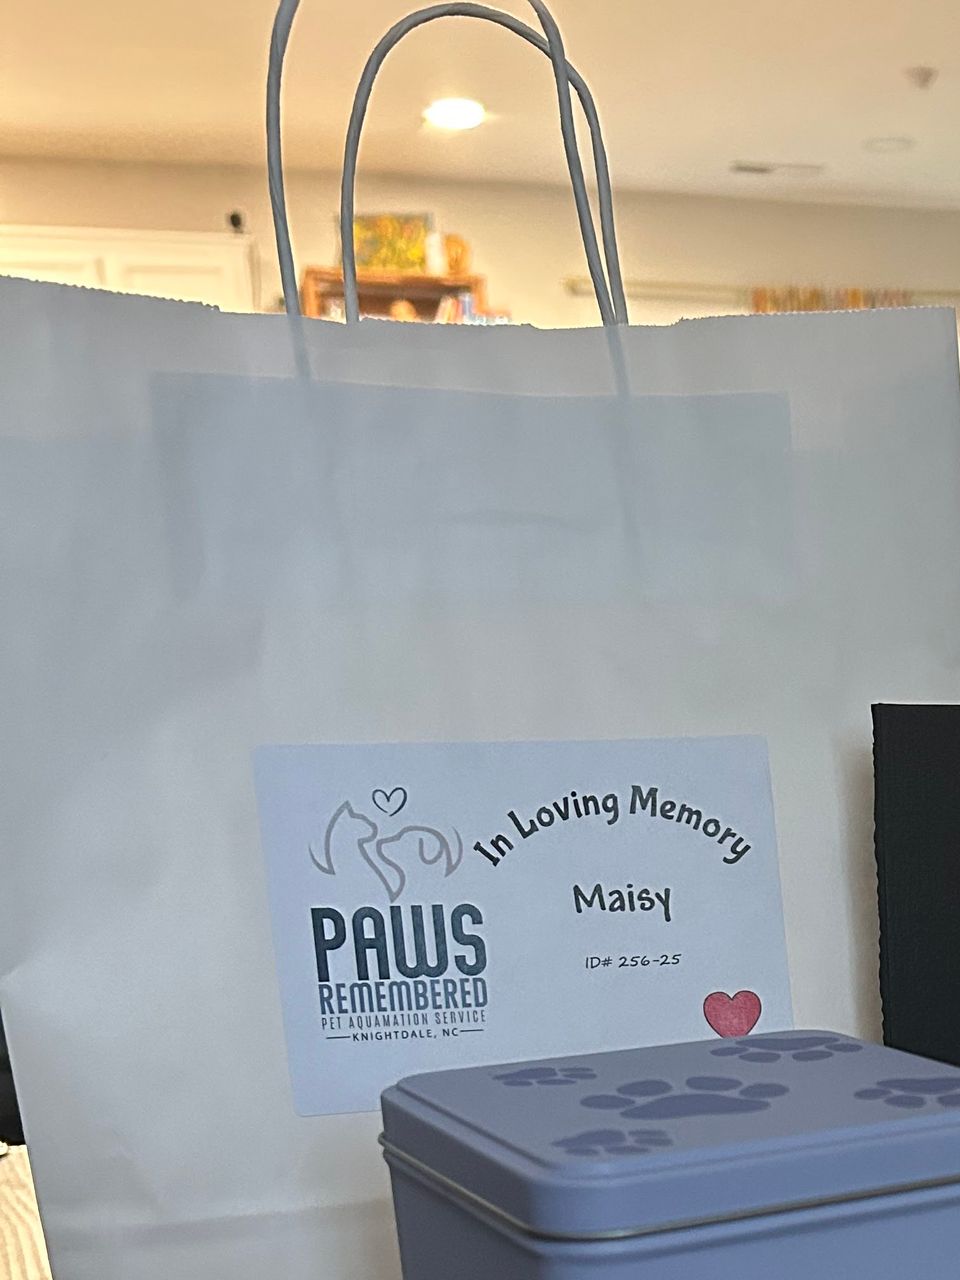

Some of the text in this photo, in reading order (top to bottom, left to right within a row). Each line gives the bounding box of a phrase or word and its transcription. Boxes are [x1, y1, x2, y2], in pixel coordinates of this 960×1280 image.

[473, 785, 752, 867] In Loving Memory
[573, 883, 671, 922] Maisy
[311, 904, 487, 982] PAWS
[585, 954, 681, 969] ID# 256-25
[318, 977, 488, 1014] REMEMBERED
[321, 1009, 487, 1031] PET AQUAMATION SERVICE
[353, 1027, 460, 1042] KNIGHTDALE, NC
